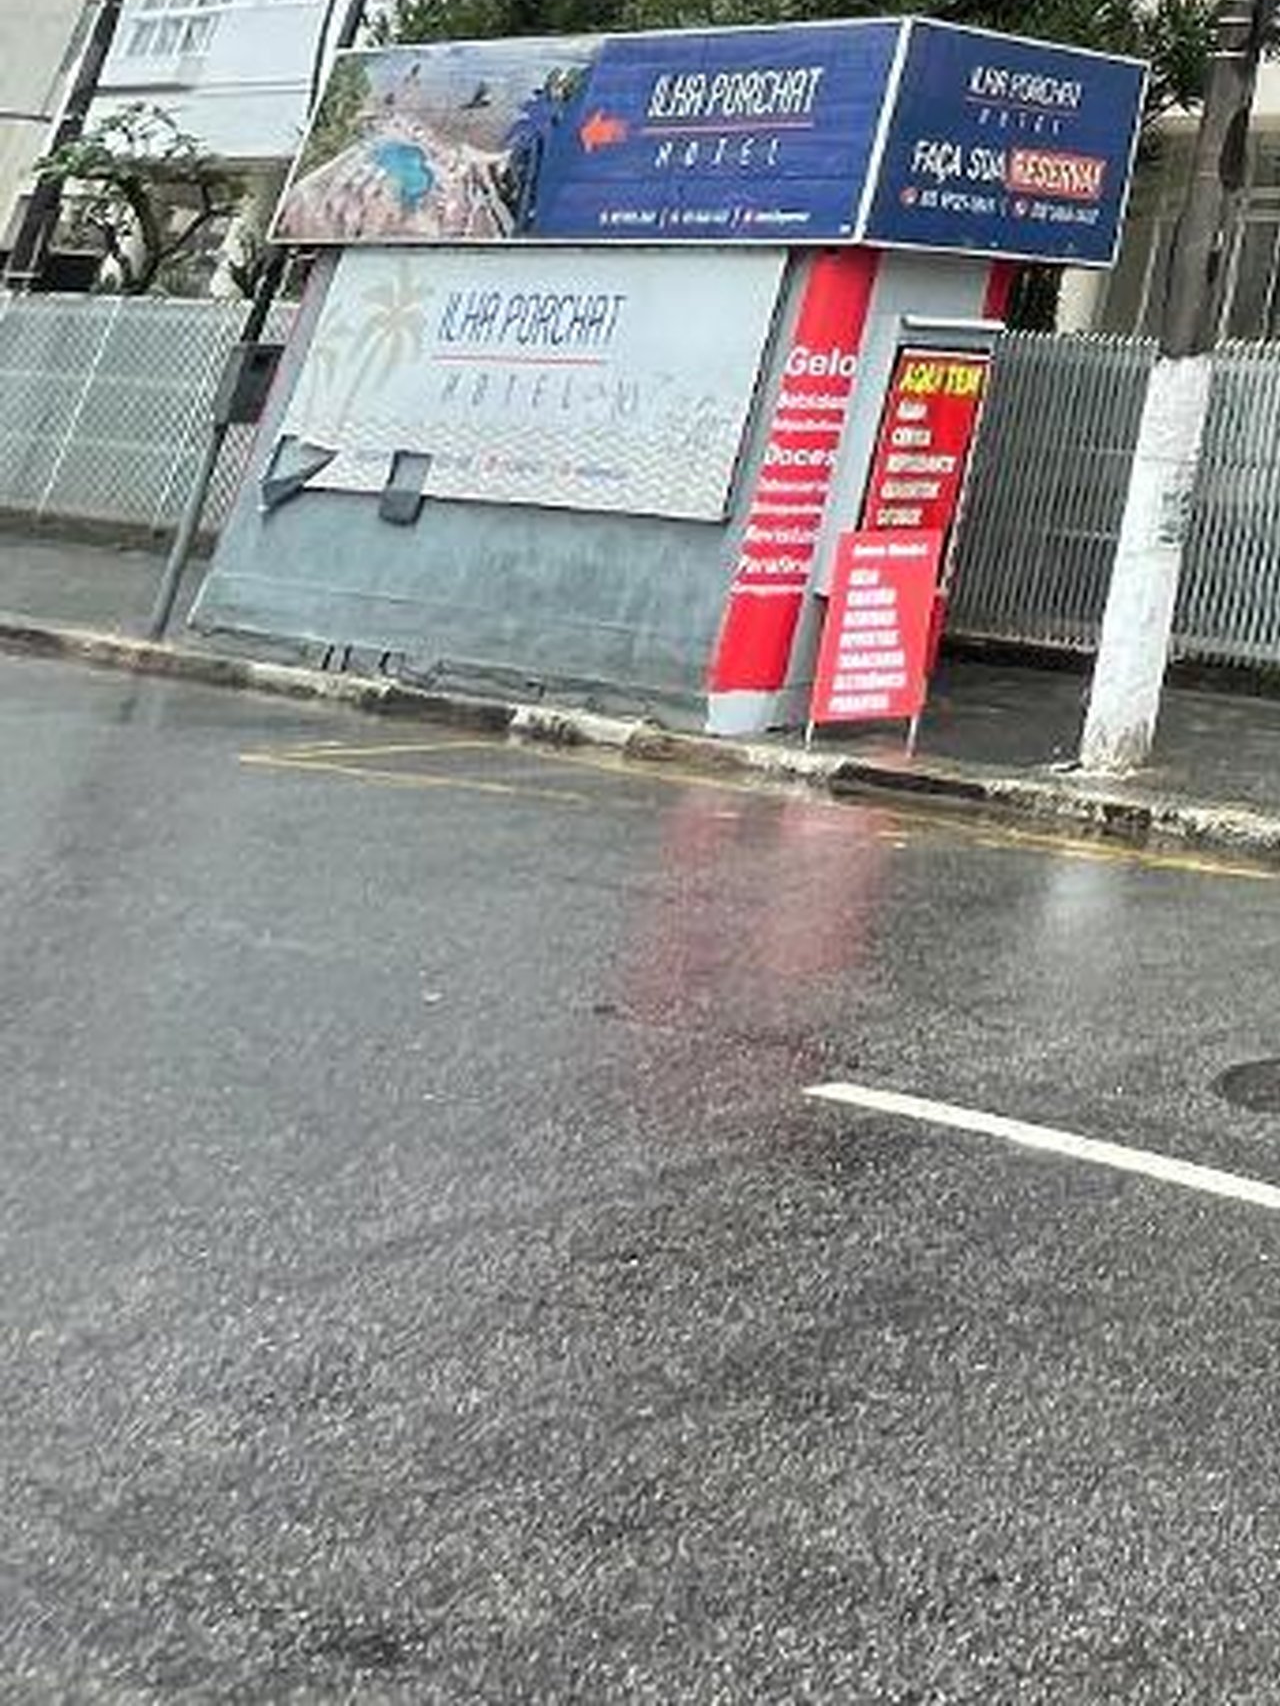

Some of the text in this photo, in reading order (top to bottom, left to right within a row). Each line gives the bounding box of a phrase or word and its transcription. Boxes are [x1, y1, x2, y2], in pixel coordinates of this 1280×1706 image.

[706, 67, 825, 116] PORCHAT
[655, 138, 781, 167] HOTEL
[911, 140, 962, 184] FAÇA
[966, 147, 1007, 182] SUA
[438, 292, 627, 345] ILHA PORCHAT
[785, 347, 858, 376] Gelo
[442, 373, 569, 409] HOTEL
[764, 443, 837, 466] Doces
